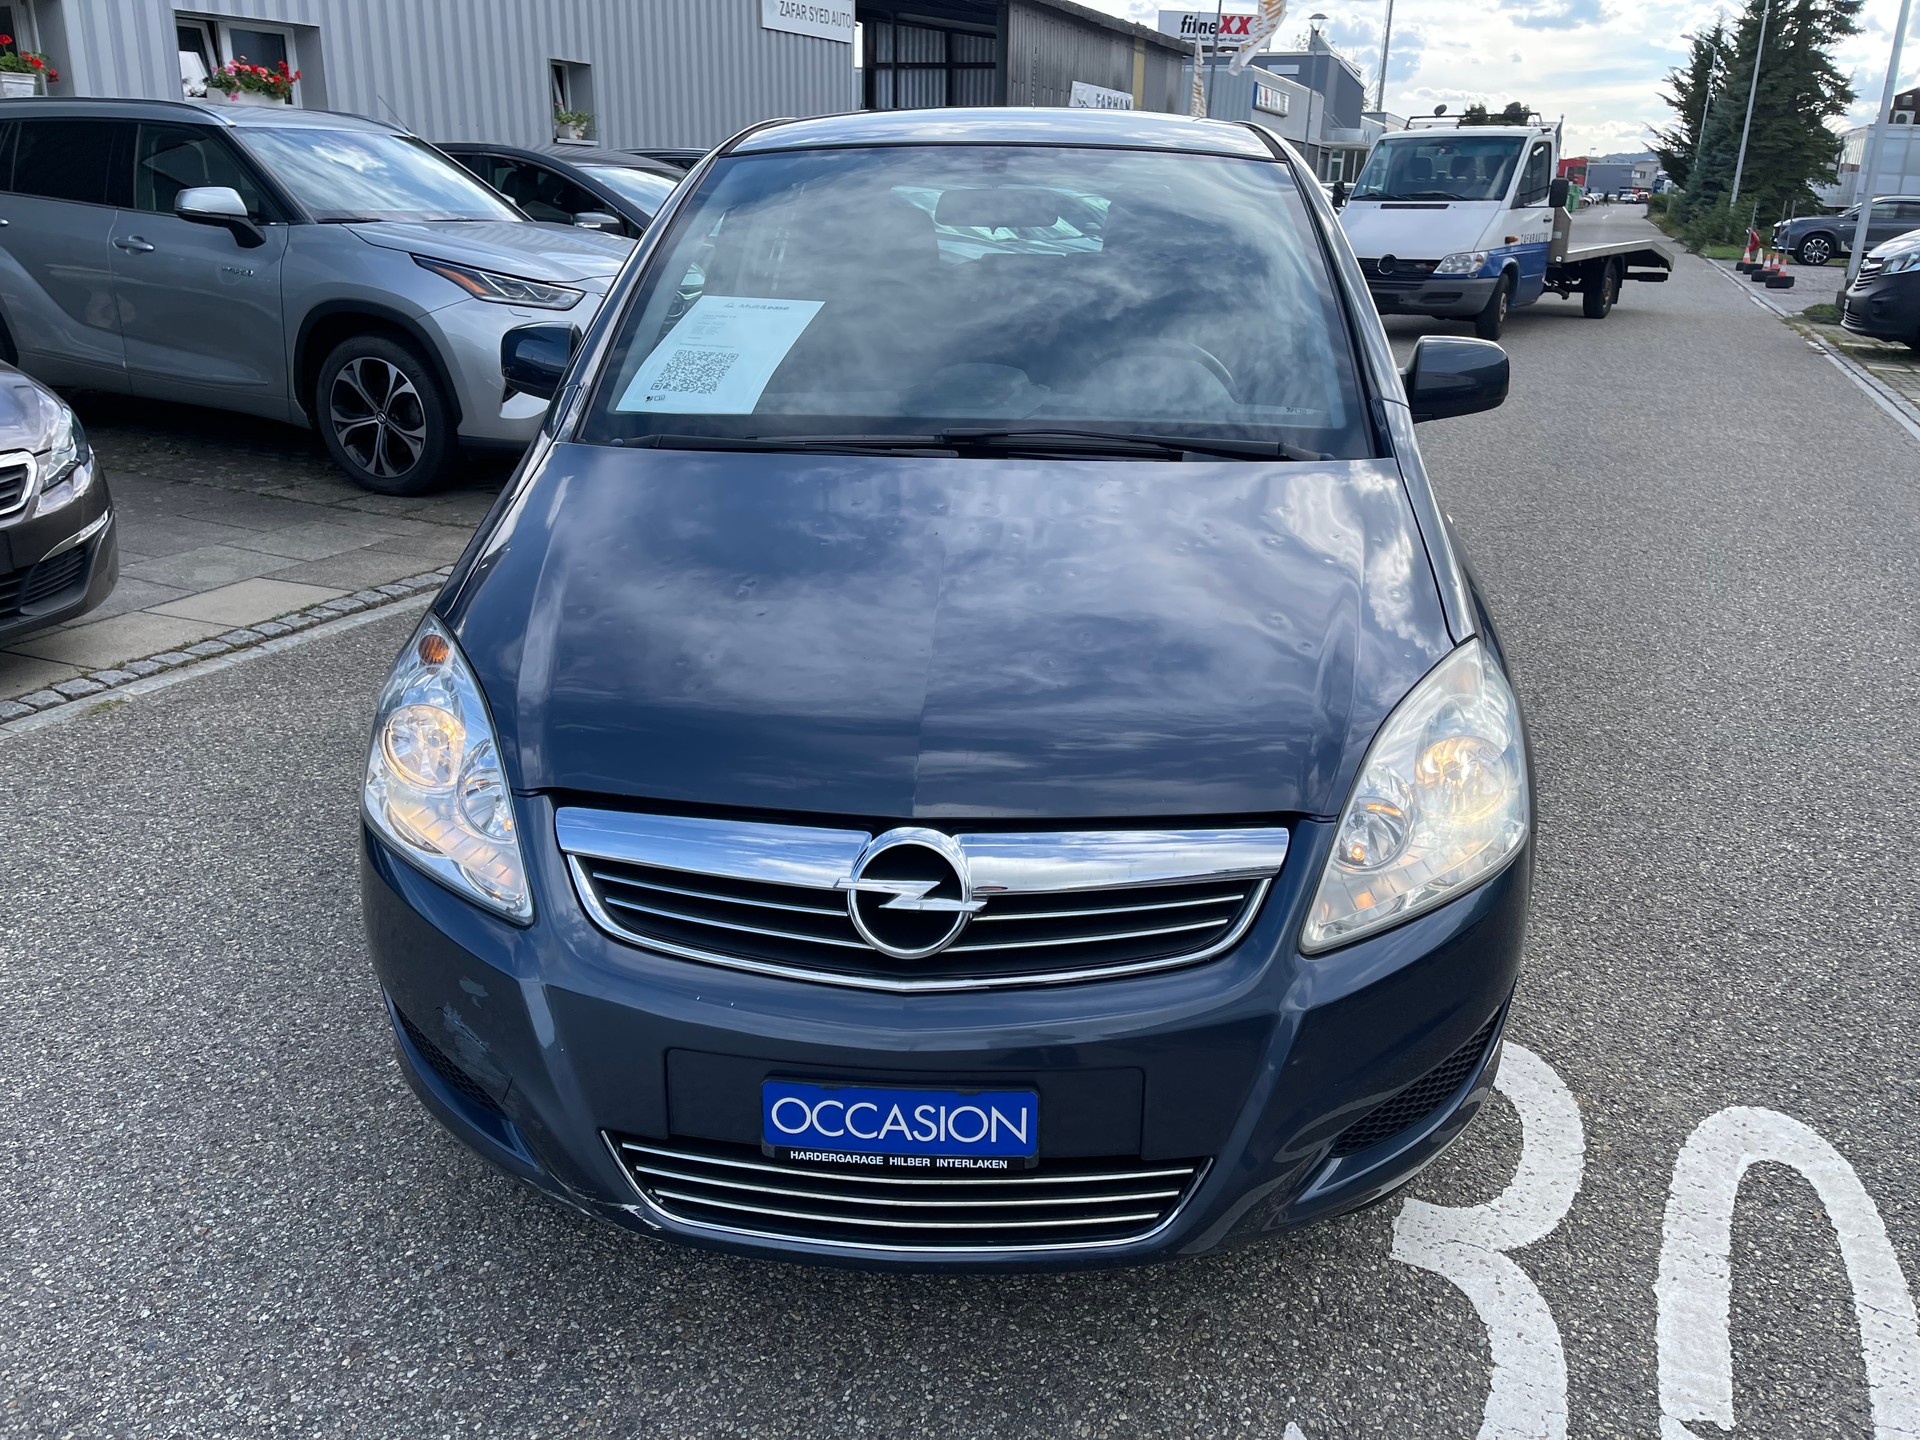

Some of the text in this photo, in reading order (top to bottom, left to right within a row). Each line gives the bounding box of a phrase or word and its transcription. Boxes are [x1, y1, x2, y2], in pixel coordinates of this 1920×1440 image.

[780, 1, 851, 28] ZAFAR SYED AUTO
[771, 1096, 1027, 1144] OCCASION
[790, 1150, 1008, 1169] HARDERGARAGE HILBER INTERLAKEN
